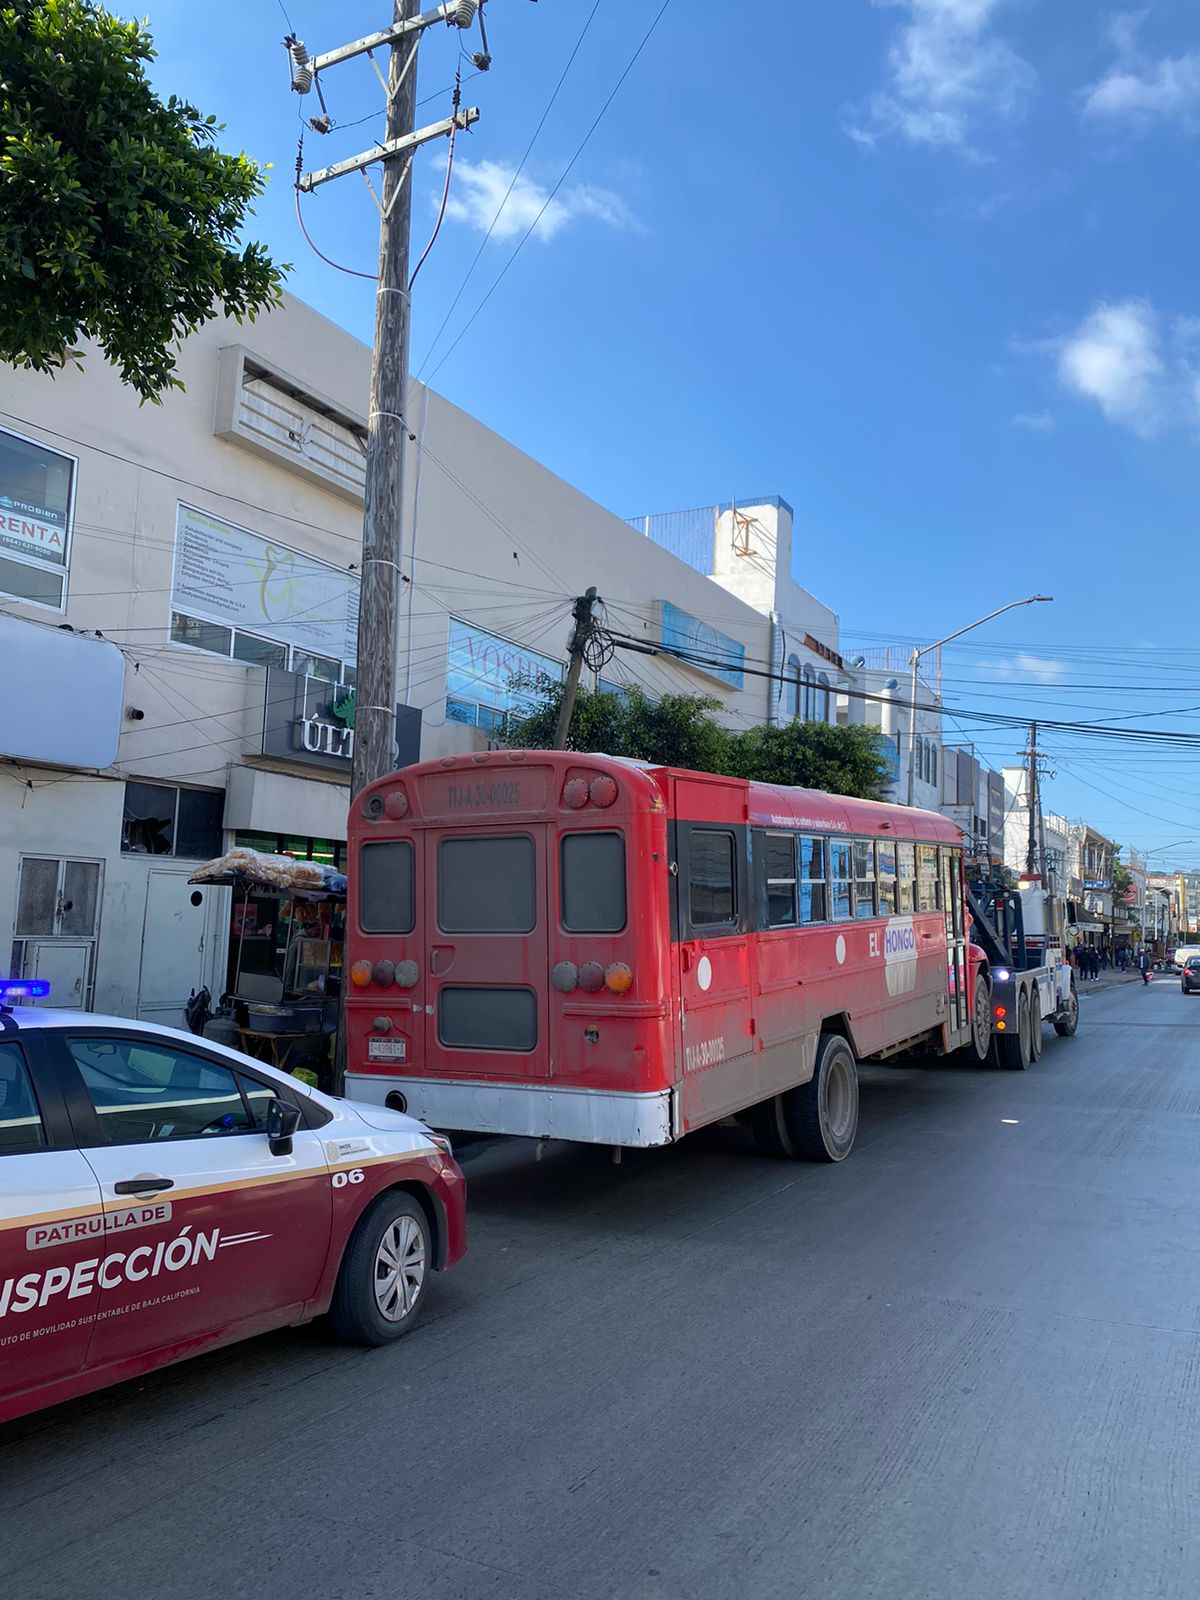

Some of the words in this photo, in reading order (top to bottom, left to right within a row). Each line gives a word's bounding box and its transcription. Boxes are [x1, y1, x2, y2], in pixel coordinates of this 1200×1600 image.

[869, 933, 880, 957] EL
[886, 928, 914, 953] HONGO
[331, 1168, 365, 1188] 06
[34, 1213, 137, 1245] PATRULLA
[141, 1206, 165, 1223] DE
[20, 1331, 31, 1341] DE
[32, 1320, 77, 1338] MOVILIDAD
[78, 1306, 130, 1326] SUSTENTABLE
[131, 1302, 141, 1311] DE
[142, 1297, 161, 1308] BAJA
[161, 1286, 201, 1303] CALIFORNIA
